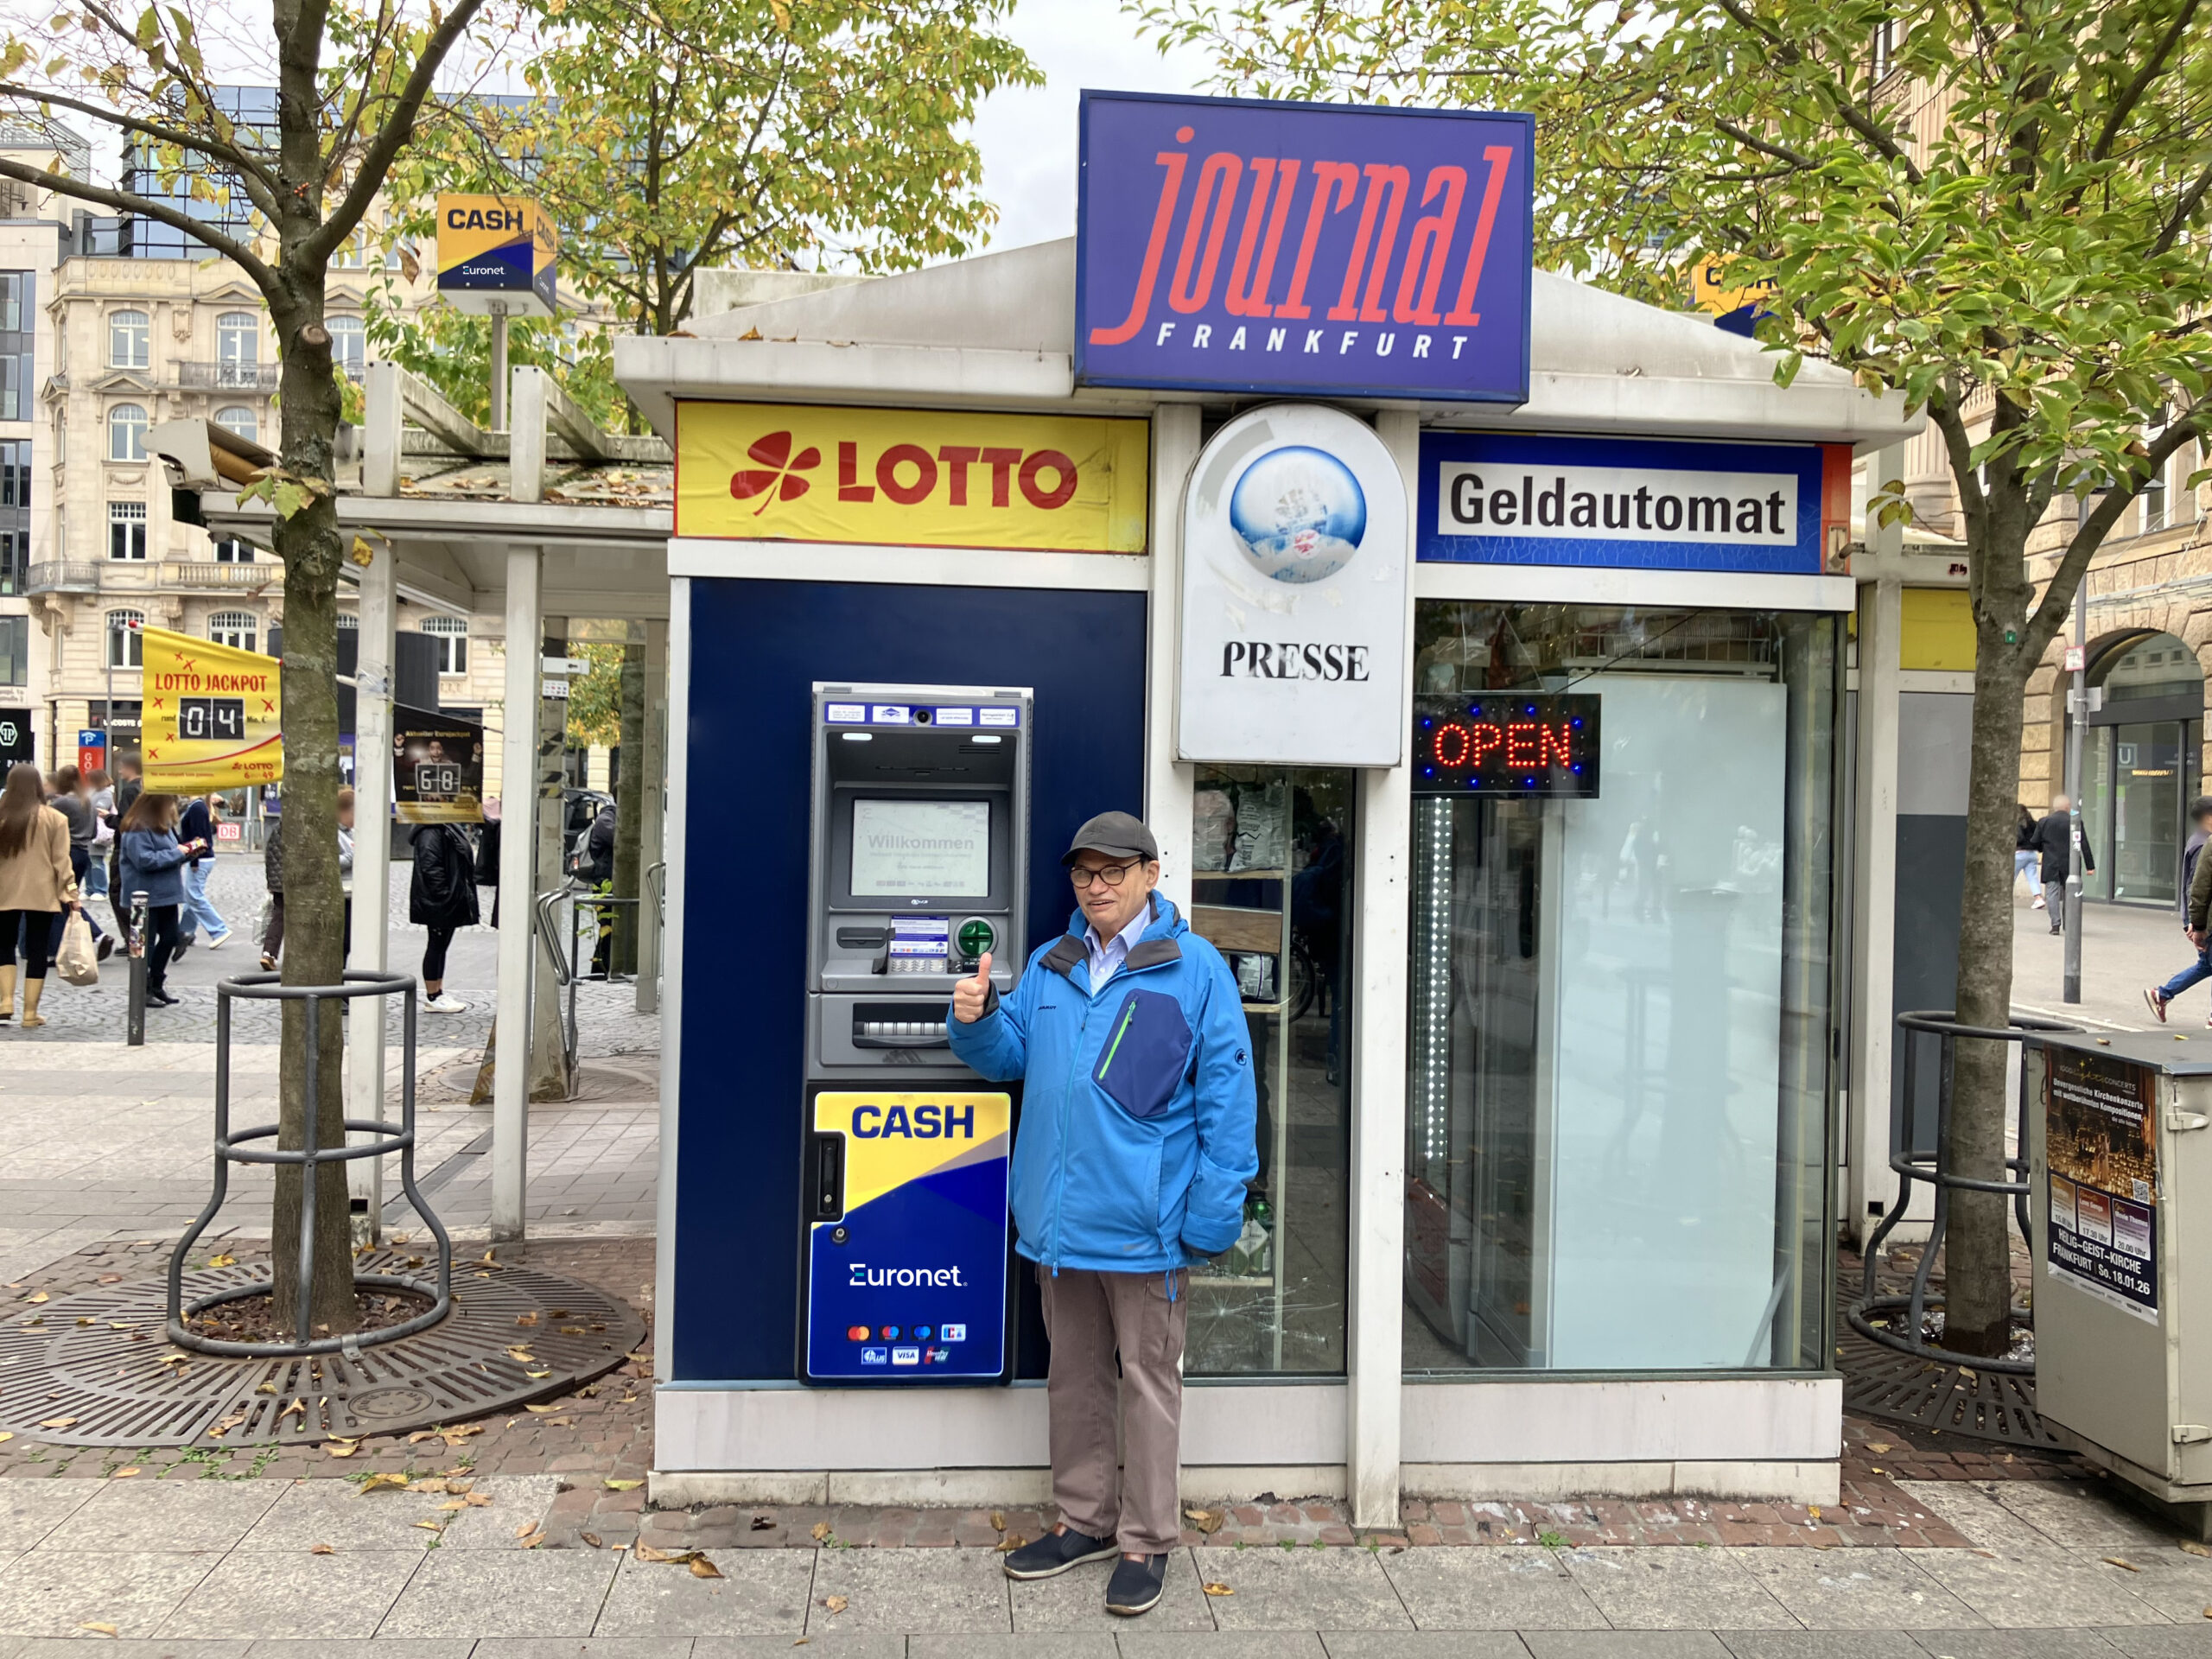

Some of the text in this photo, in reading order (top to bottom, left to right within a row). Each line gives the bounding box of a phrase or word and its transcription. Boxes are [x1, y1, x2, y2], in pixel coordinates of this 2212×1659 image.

[448, 209, 523, 231] CASH
[1089, 126, 1513, 346] journal
[462, 266, 505, 275] Euronet
[1156, 322, 1468, 360] FRANKFURT
[838, 442, 1078, 510] LOTTO
[1450, 473, 1786, 535] Geldautomat
[1219, 641, 1370, 682] PRESSE
[156, 673, 268, 692] LOTTO JACKPOT
[1434, 723, 1571, 767] OPEN
[2119, 748, 2132, 764] U
[220, 826, 238, 837] DB
[868, 835, 975, 849] Willkommen
[2105, 1077, 2137, 1091] CONCERTS
[2094, 1089, 2144, 1110] Kirchenkonzerte
[852, 1105, 974, 1138] CASH
[2100, 1102, 2144, 1122] Kompositionen,
[2082, 1228, 2108, 1243] 17.30 Uhr
[2053, 1242, 2092, 1271] FRANKFURT
[2099, 1263, 2111, 1280] So.
[2113, 1270, 2151, 1295] 18.01.26
